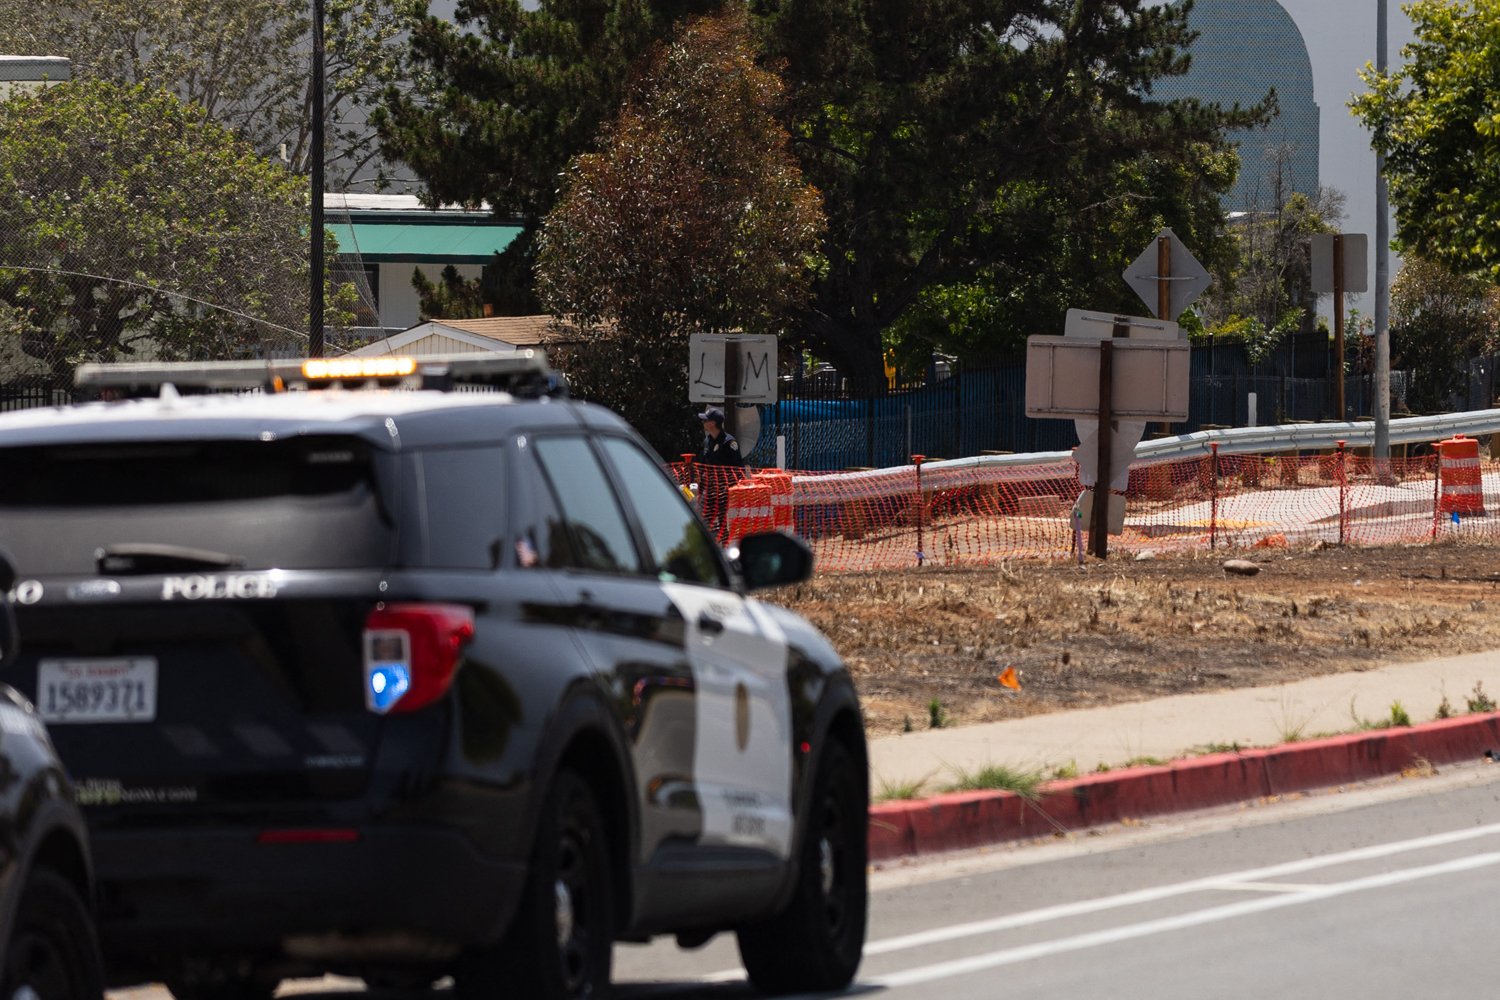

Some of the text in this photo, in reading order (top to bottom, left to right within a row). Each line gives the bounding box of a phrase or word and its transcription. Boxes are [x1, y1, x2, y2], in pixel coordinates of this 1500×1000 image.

[694, 351, 771, 391] L M
[161, 575, 279, 600] POLICE
[47, 679, 146, 714] 1589371
